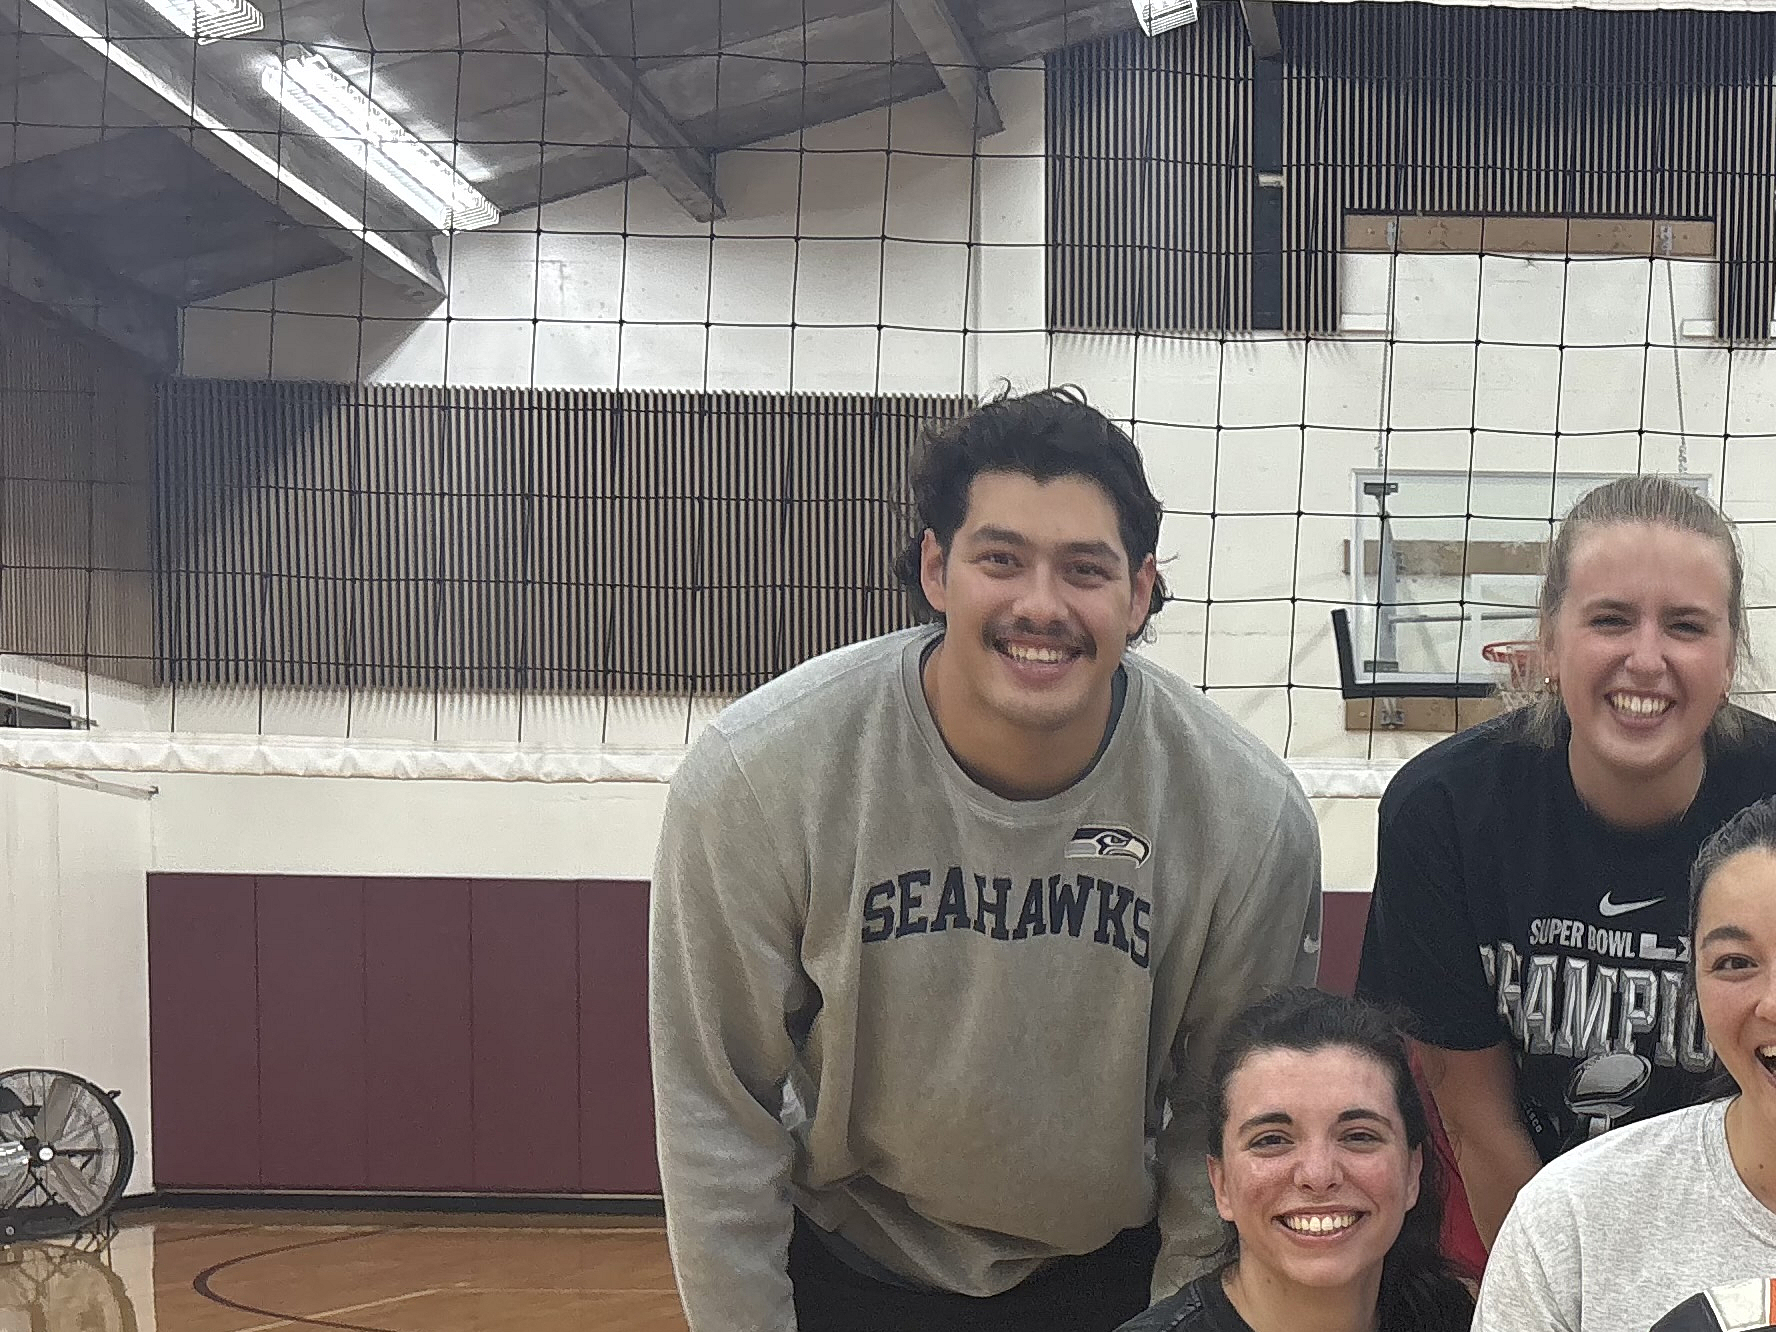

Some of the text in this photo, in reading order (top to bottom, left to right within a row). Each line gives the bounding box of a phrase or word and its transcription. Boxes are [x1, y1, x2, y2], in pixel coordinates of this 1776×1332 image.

[861, 866, 1151, 969] SEAHAWKS
[1530, 918, 1585, 949] SUPER
[1587, 924, 1636, 958] BOWL
